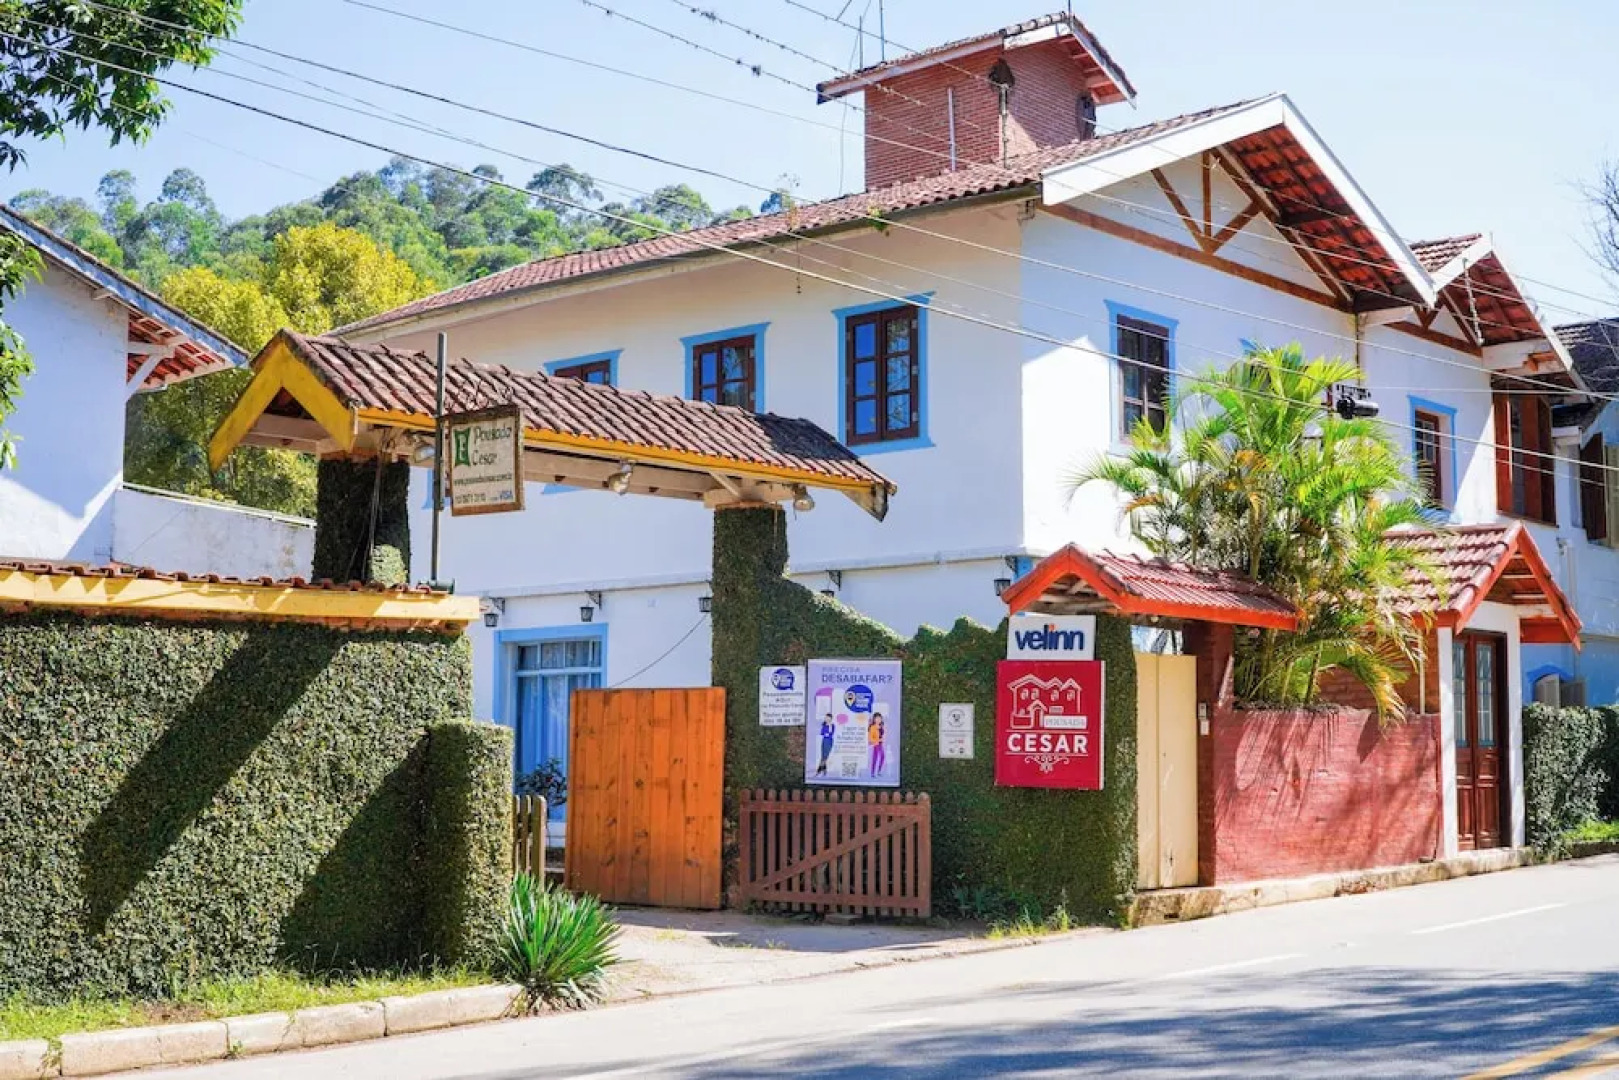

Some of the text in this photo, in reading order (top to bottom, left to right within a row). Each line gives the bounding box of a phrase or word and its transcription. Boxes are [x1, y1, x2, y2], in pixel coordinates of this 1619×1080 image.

[1015, 623, 1085, 651] velinn
[822, 674, 893, 684] DESABAFAR?
[1007, 733, 1088, 753] CESAR
